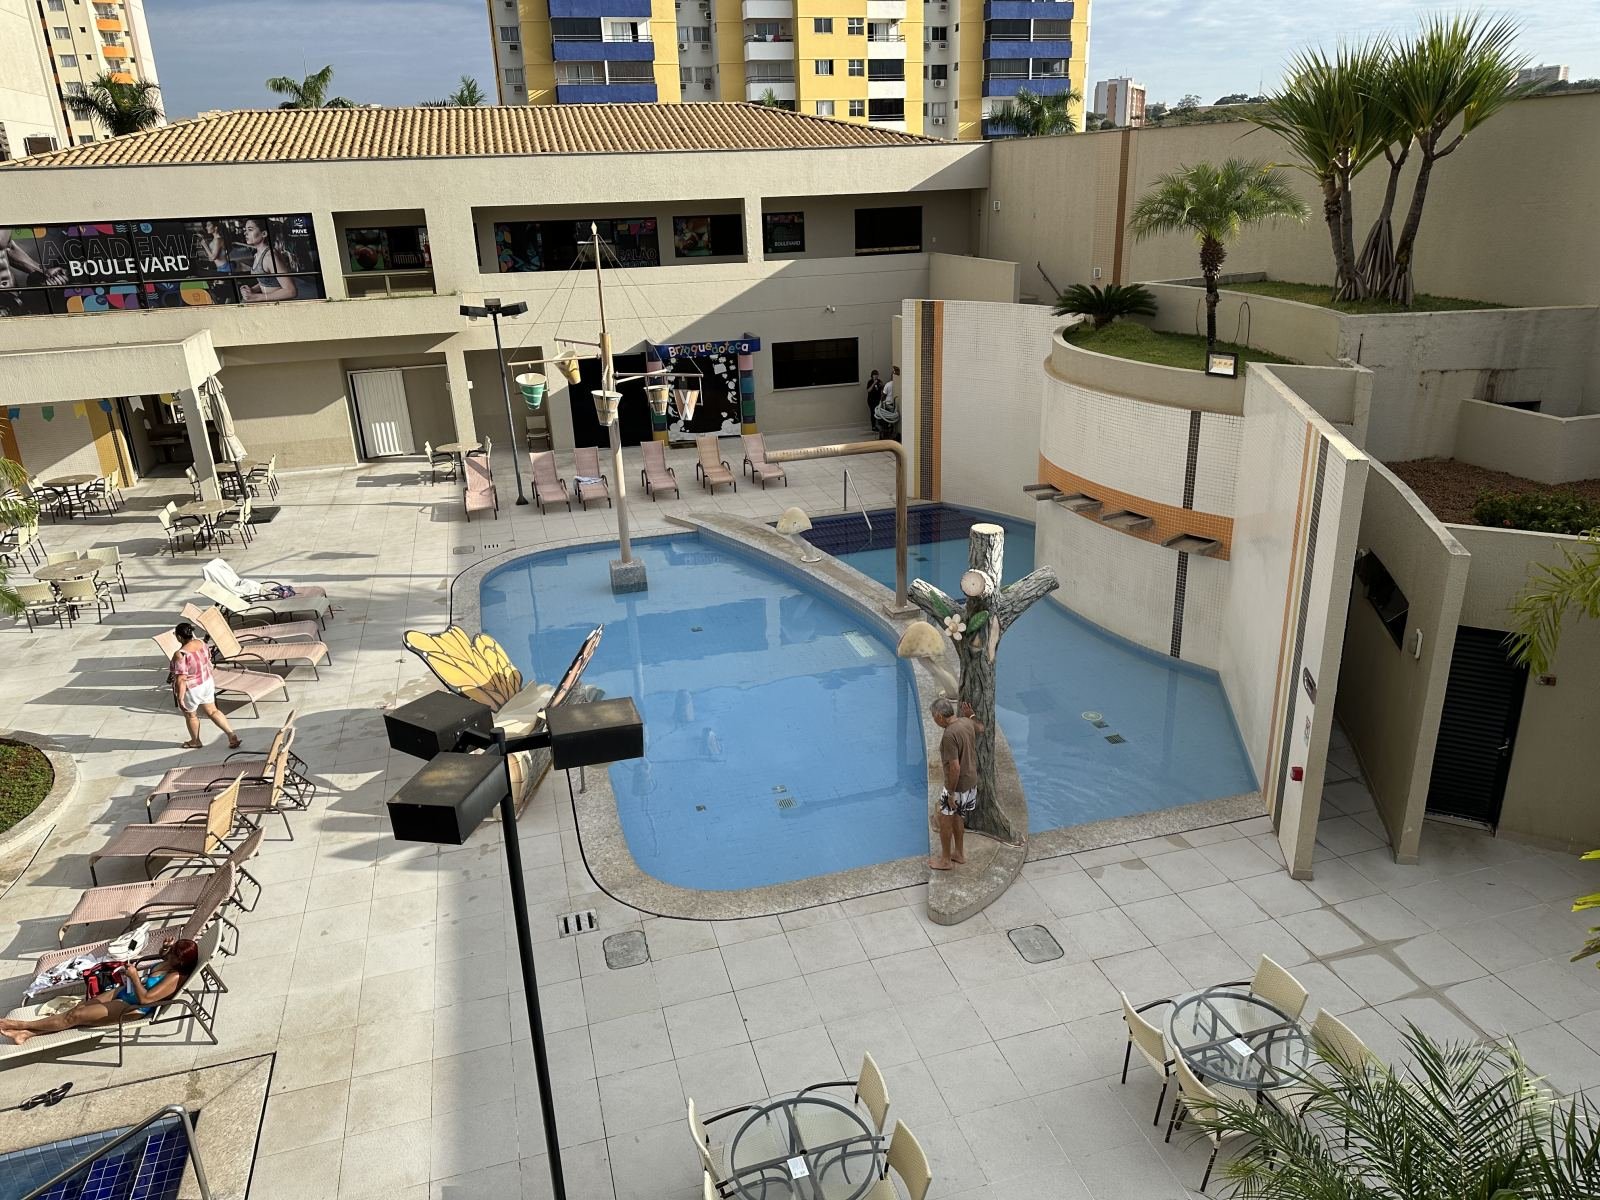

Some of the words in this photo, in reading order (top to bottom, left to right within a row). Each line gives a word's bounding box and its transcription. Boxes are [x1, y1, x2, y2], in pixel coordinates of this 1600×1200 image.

[41, 234, 209, 265] ACADEMIA
[69, 255, 190, 277] BOULEVARD
[668, 342, 749, 358] Brinquedoteca
